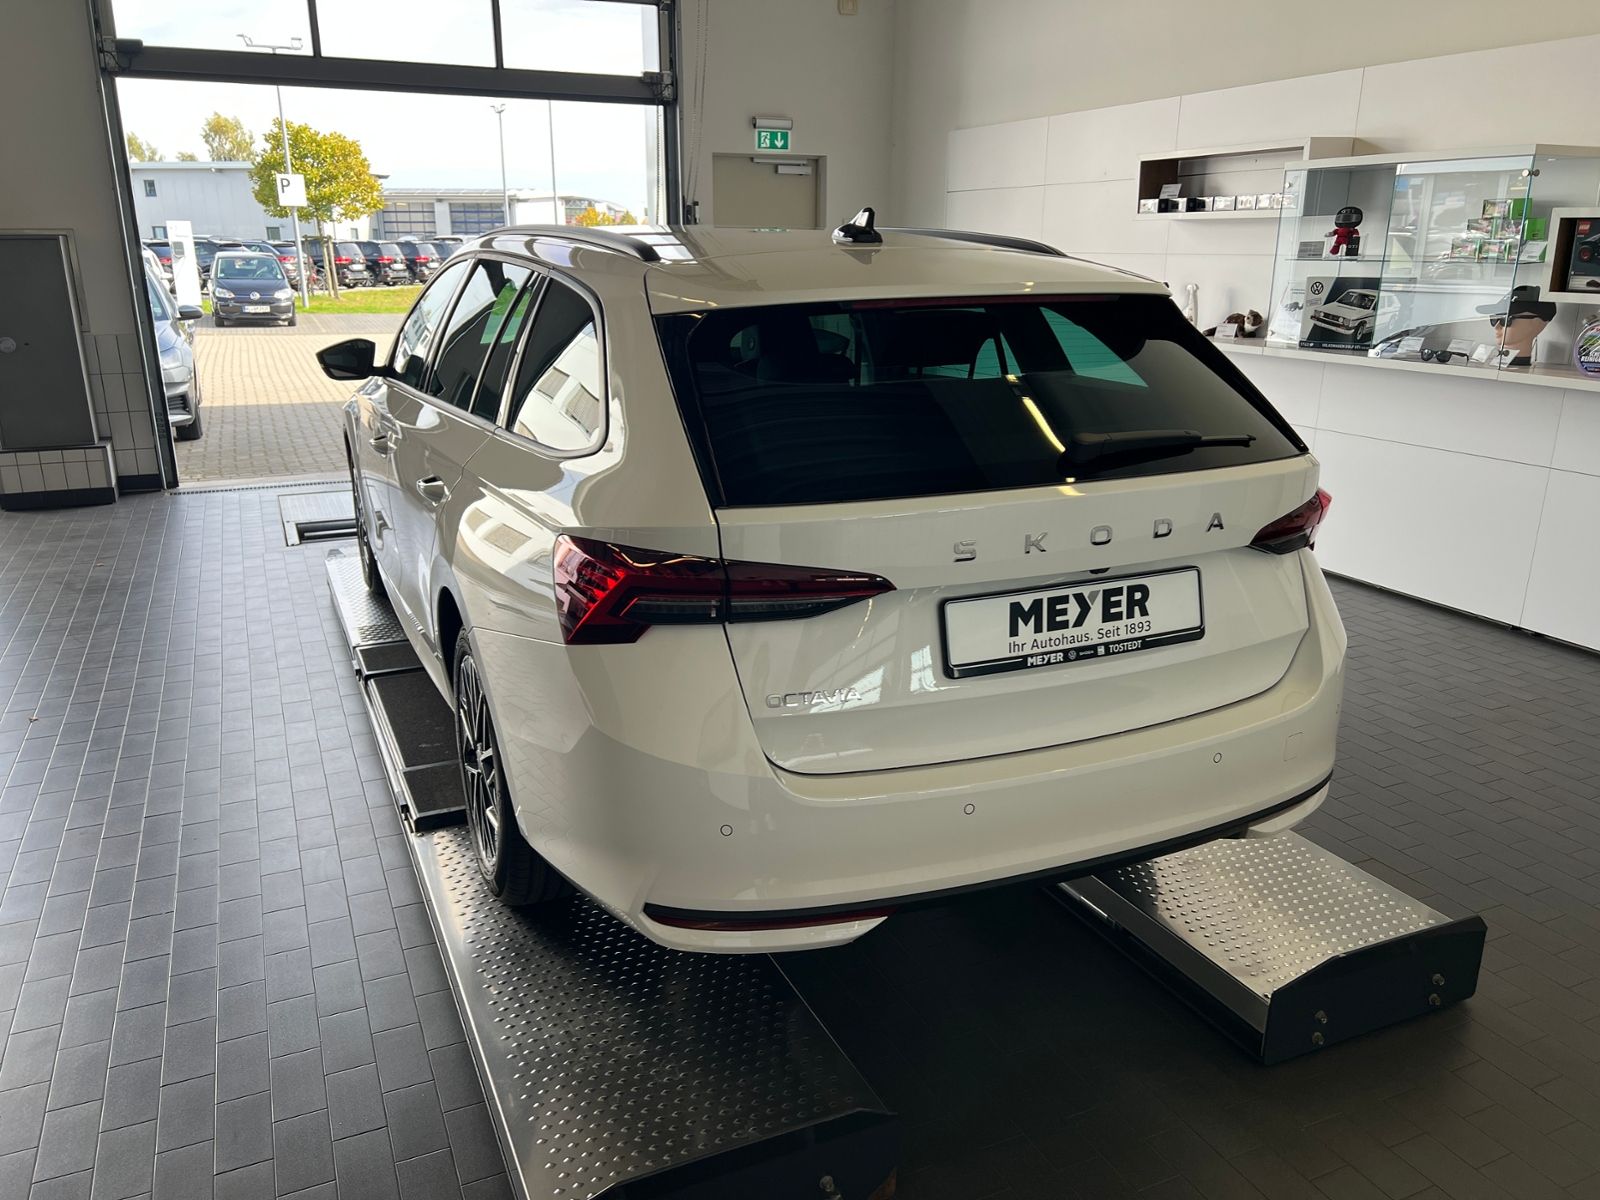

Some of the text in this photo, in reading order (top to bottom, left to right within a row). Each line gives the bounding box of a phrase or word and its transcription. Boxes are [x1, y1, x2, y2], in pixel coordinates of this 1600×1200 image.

[280, 178, 290, 194] P
[1009, 583, 1150, 638] MEYER
[1008, 620, 1151, 654] Ihr Autohaus. Seit 1893
[1027, 652, 1064, 667] MEYER
[1109, 640, 1142, 653] TOSTEDT
[766, 687, 862, 708] OCTAVIA
